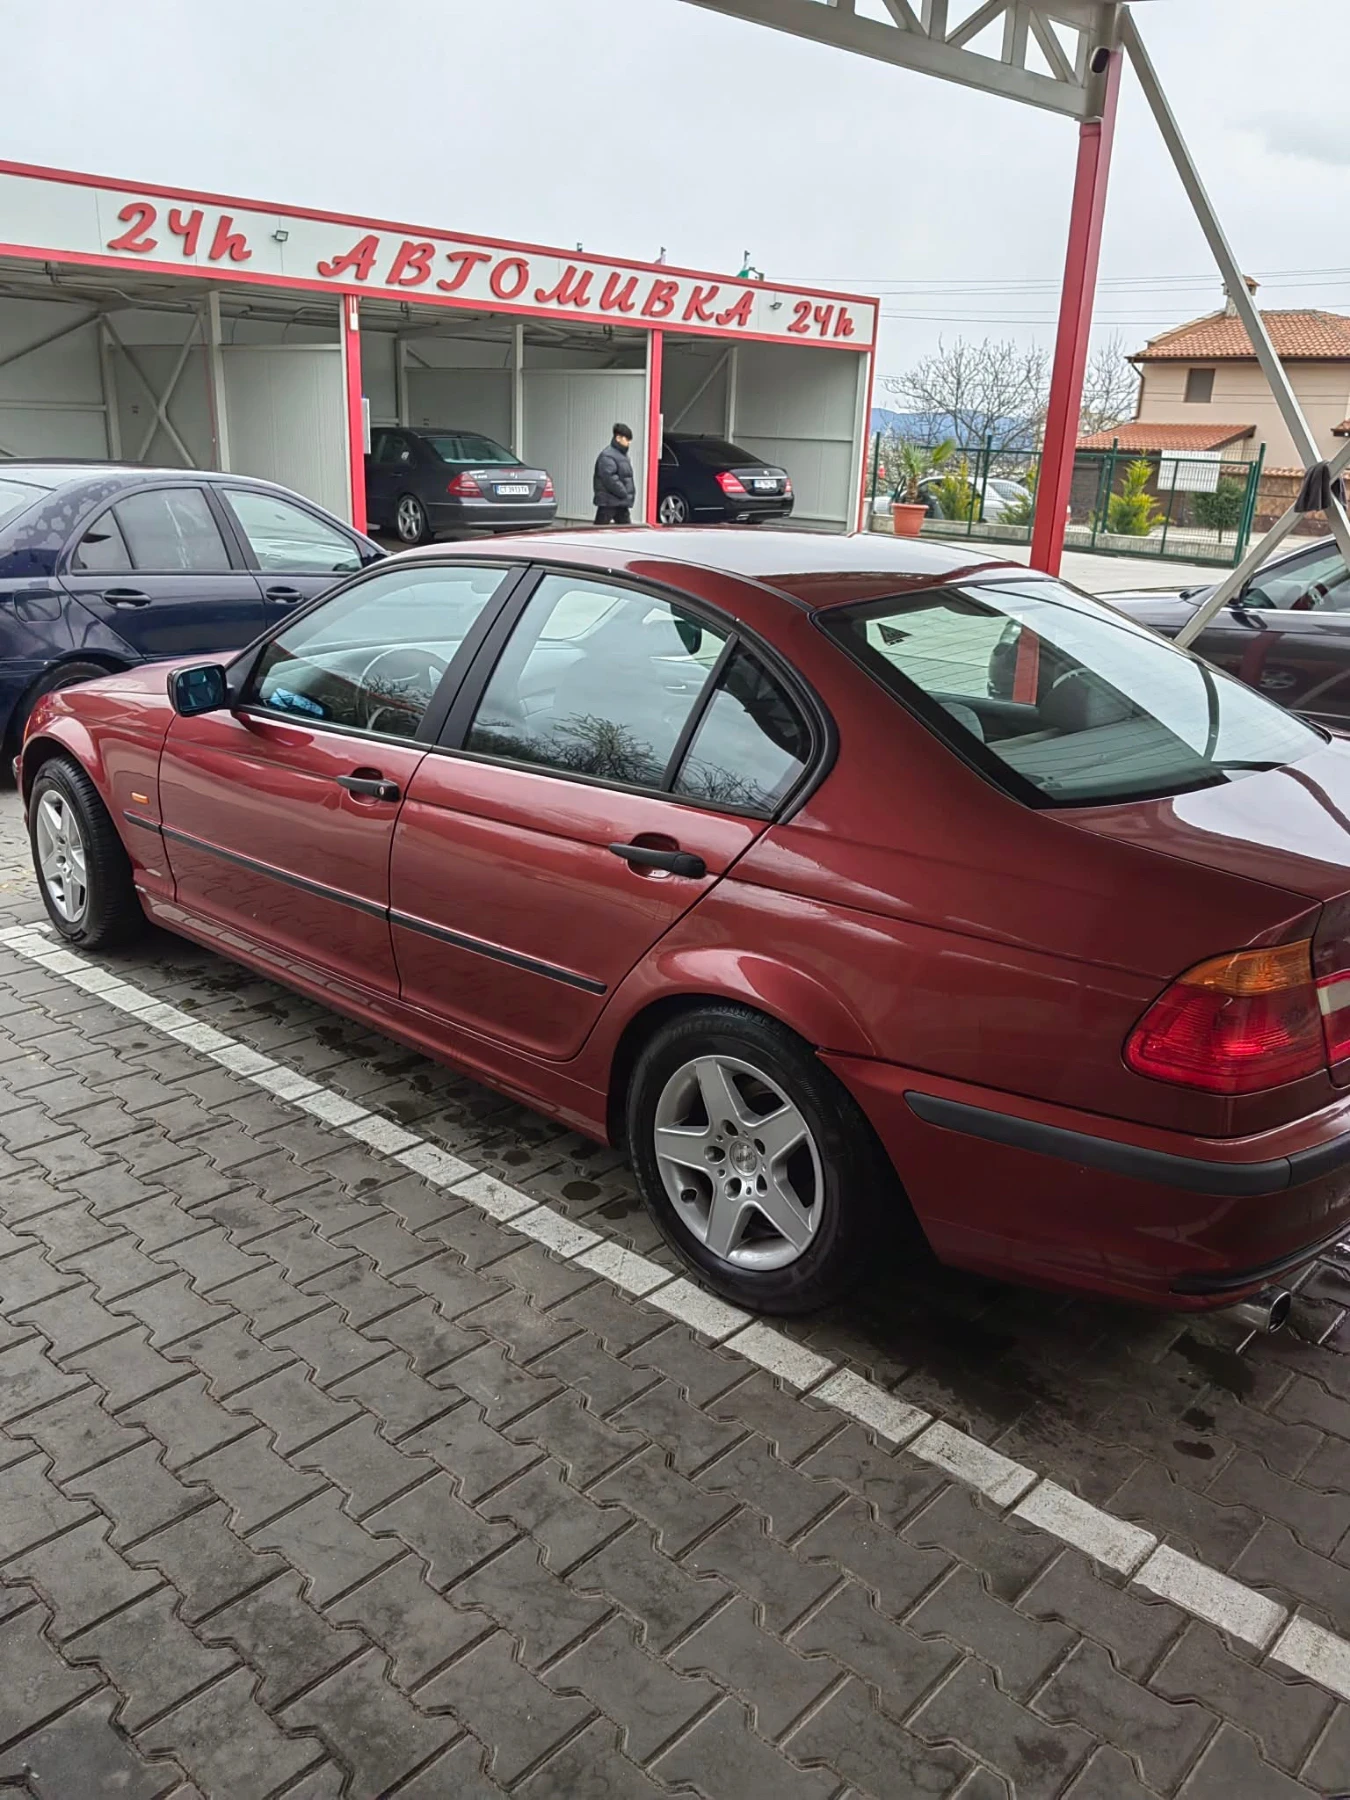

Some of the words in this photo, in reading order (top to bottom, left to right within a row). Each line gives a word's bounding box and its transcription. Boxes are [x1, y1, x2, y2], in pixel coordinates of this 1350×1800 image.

[107, 202, 252, 262] 24h
[317, 234, 755, 326] АВТОМИВКА
[788, 300, 854, 337] 24h
